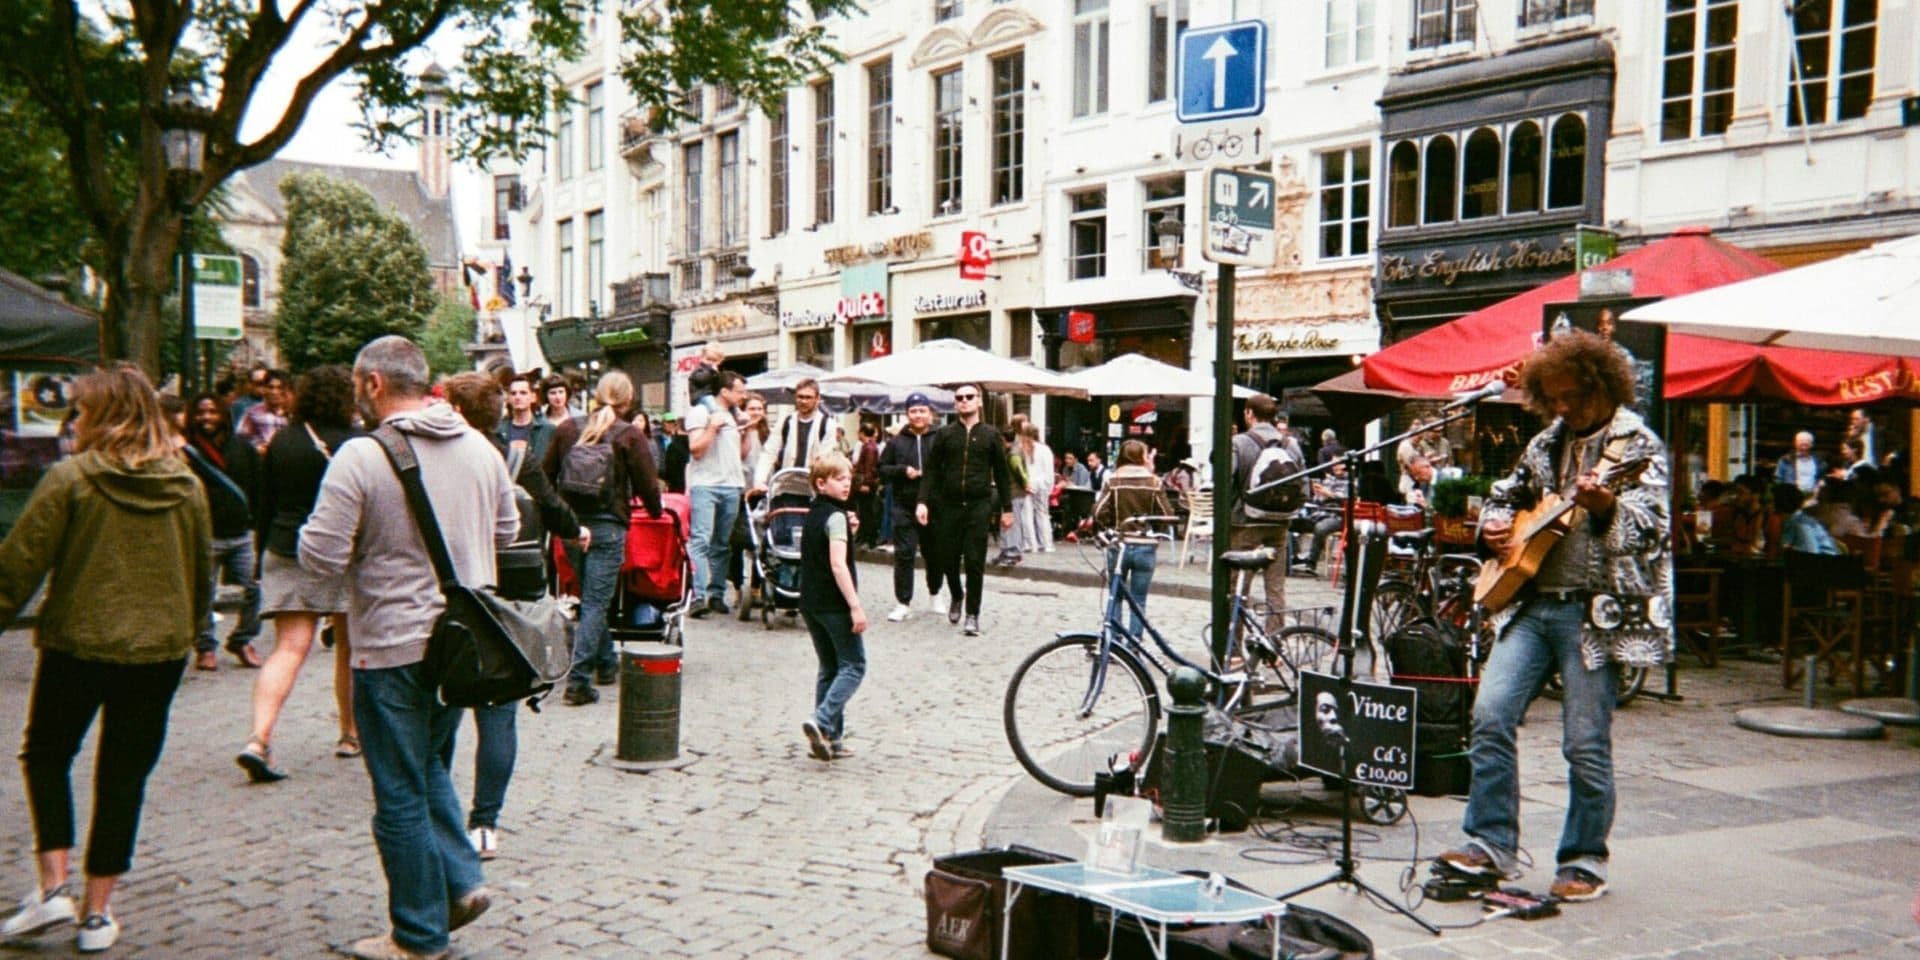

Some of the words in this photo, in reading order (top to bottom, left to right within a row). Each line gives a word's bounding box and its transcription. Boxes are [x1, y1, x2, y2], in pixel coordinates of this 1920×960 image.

[969, 235, 988, 260] Q
[1381, 254, 1417, 282] The
[1418, 247, 1501, 287] English
[1504, 238, 1577, 271] House
[836, 291, 886, 325] Quick
[911, 289, 987, 313] Restaurant
[872, 330, 885, 353] Q
[1347, 690, 1408, 722] Vince
[1373, 745, 1408, 764] Cd's
[1355, 763, 1408, 783] €10,00
